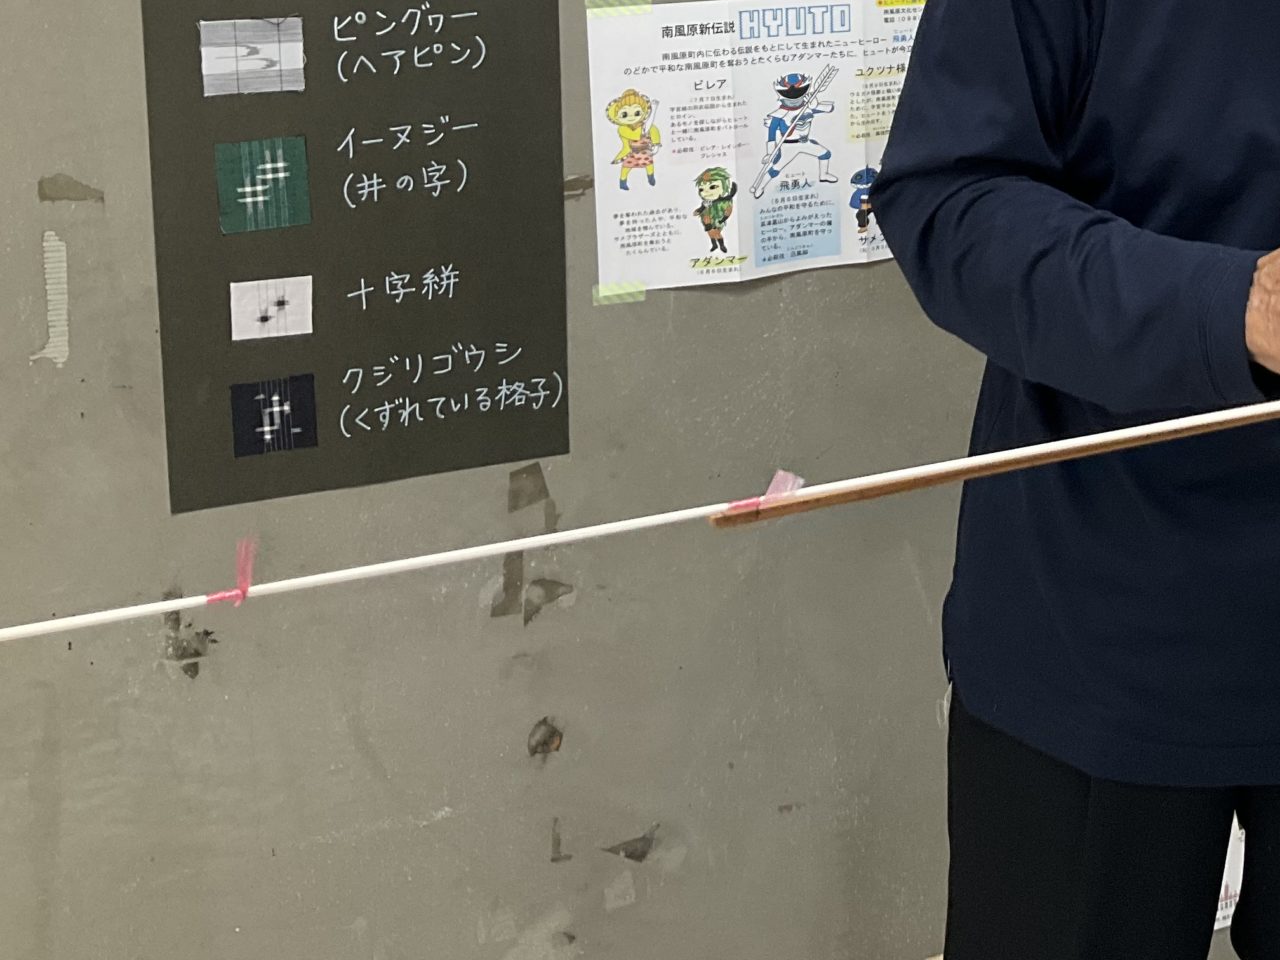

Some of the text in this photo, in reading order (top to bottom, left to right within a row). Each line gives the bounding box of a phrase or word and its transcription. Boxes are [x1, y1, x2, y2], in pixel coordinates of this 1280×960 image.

[661, 3, 851, 40] 南風原新伝説 HYUTO
[337, 35, 486, 83] （ヘアピン）
[337, 115, 479, 159] イーヌジー
[343, 158, 468, 209] （井の字）
[342, 341, 522, 394] クジリゴウシ
[340, 370, 563, 438] （くずれている格子）
